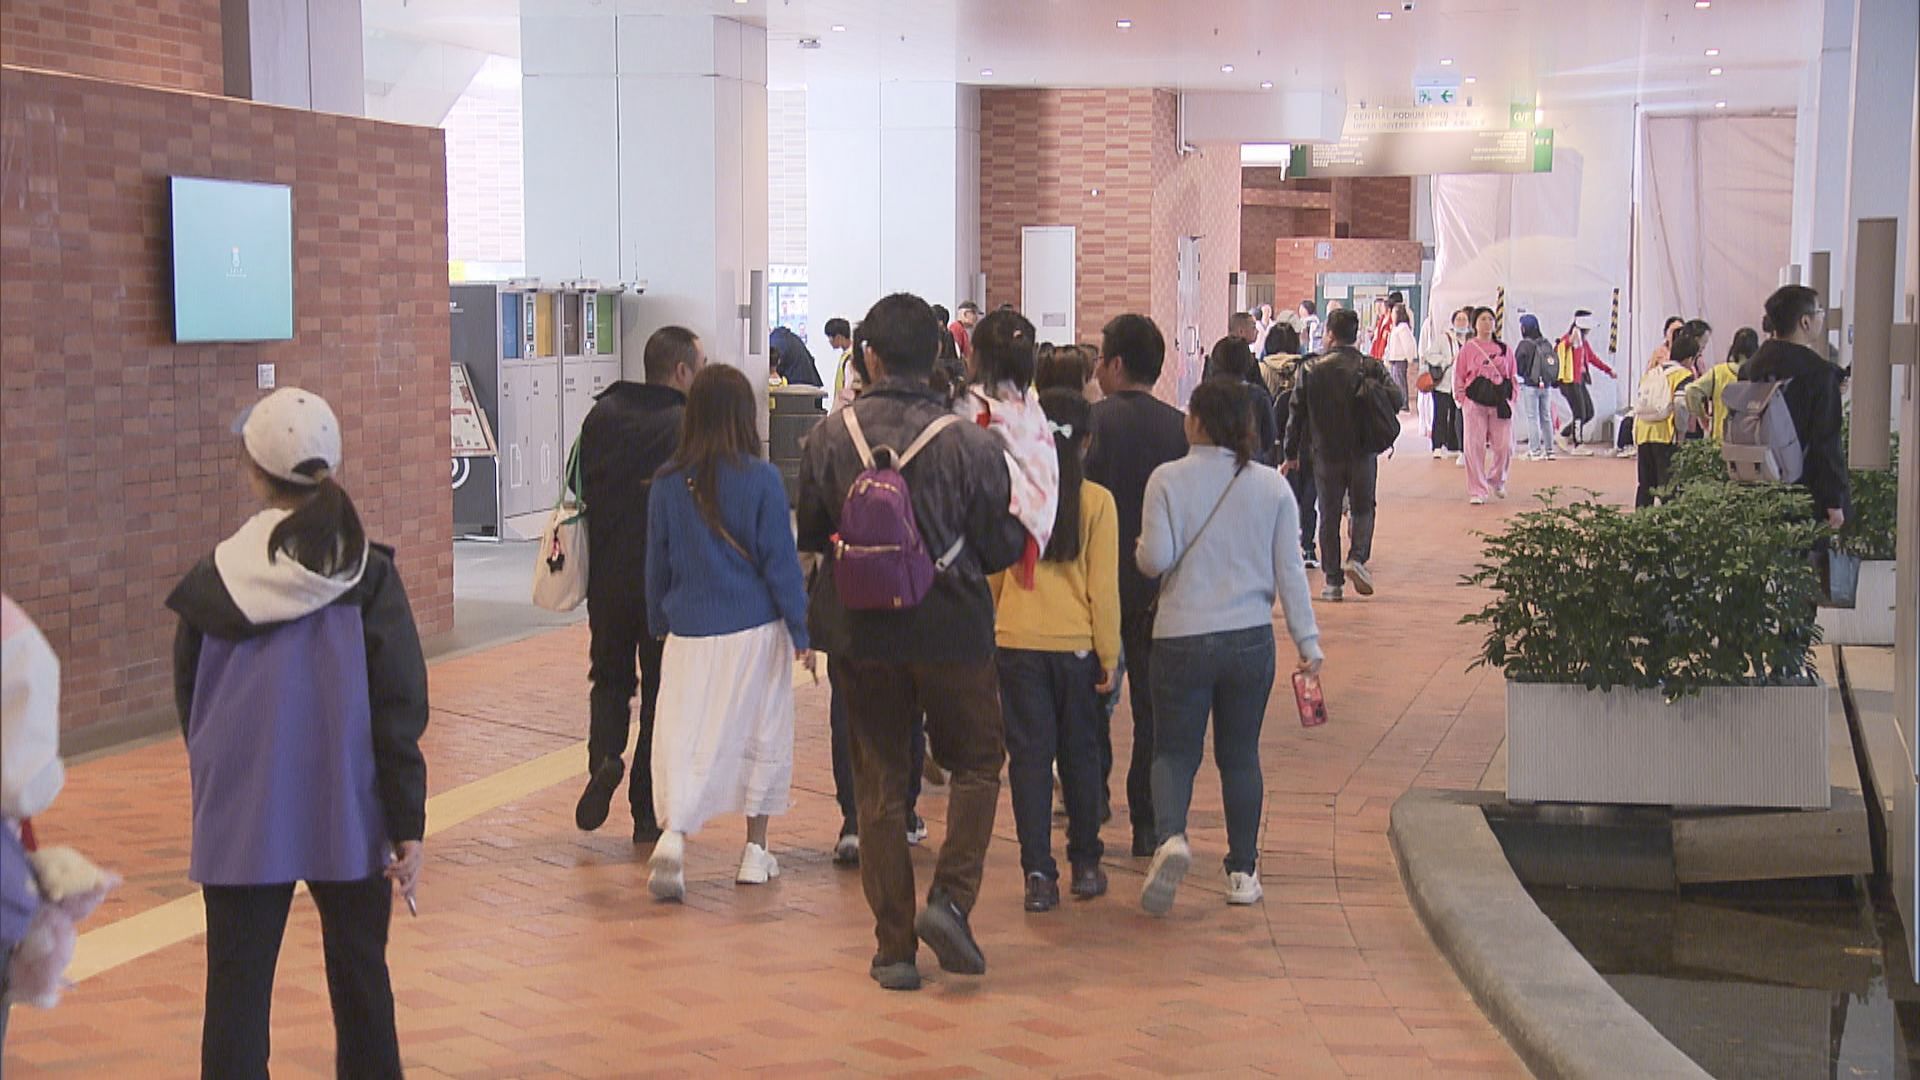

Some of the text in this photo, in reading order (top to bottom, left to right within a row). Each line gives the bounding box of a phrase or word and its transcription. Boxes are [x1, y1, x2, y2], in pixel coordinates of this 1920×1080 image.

[1353, 111, 1391, 120] CENTRAL
[1393, 110, 1424, 119] PODIUM
[1380, 119, 1419, 129] UNIVERSITY
